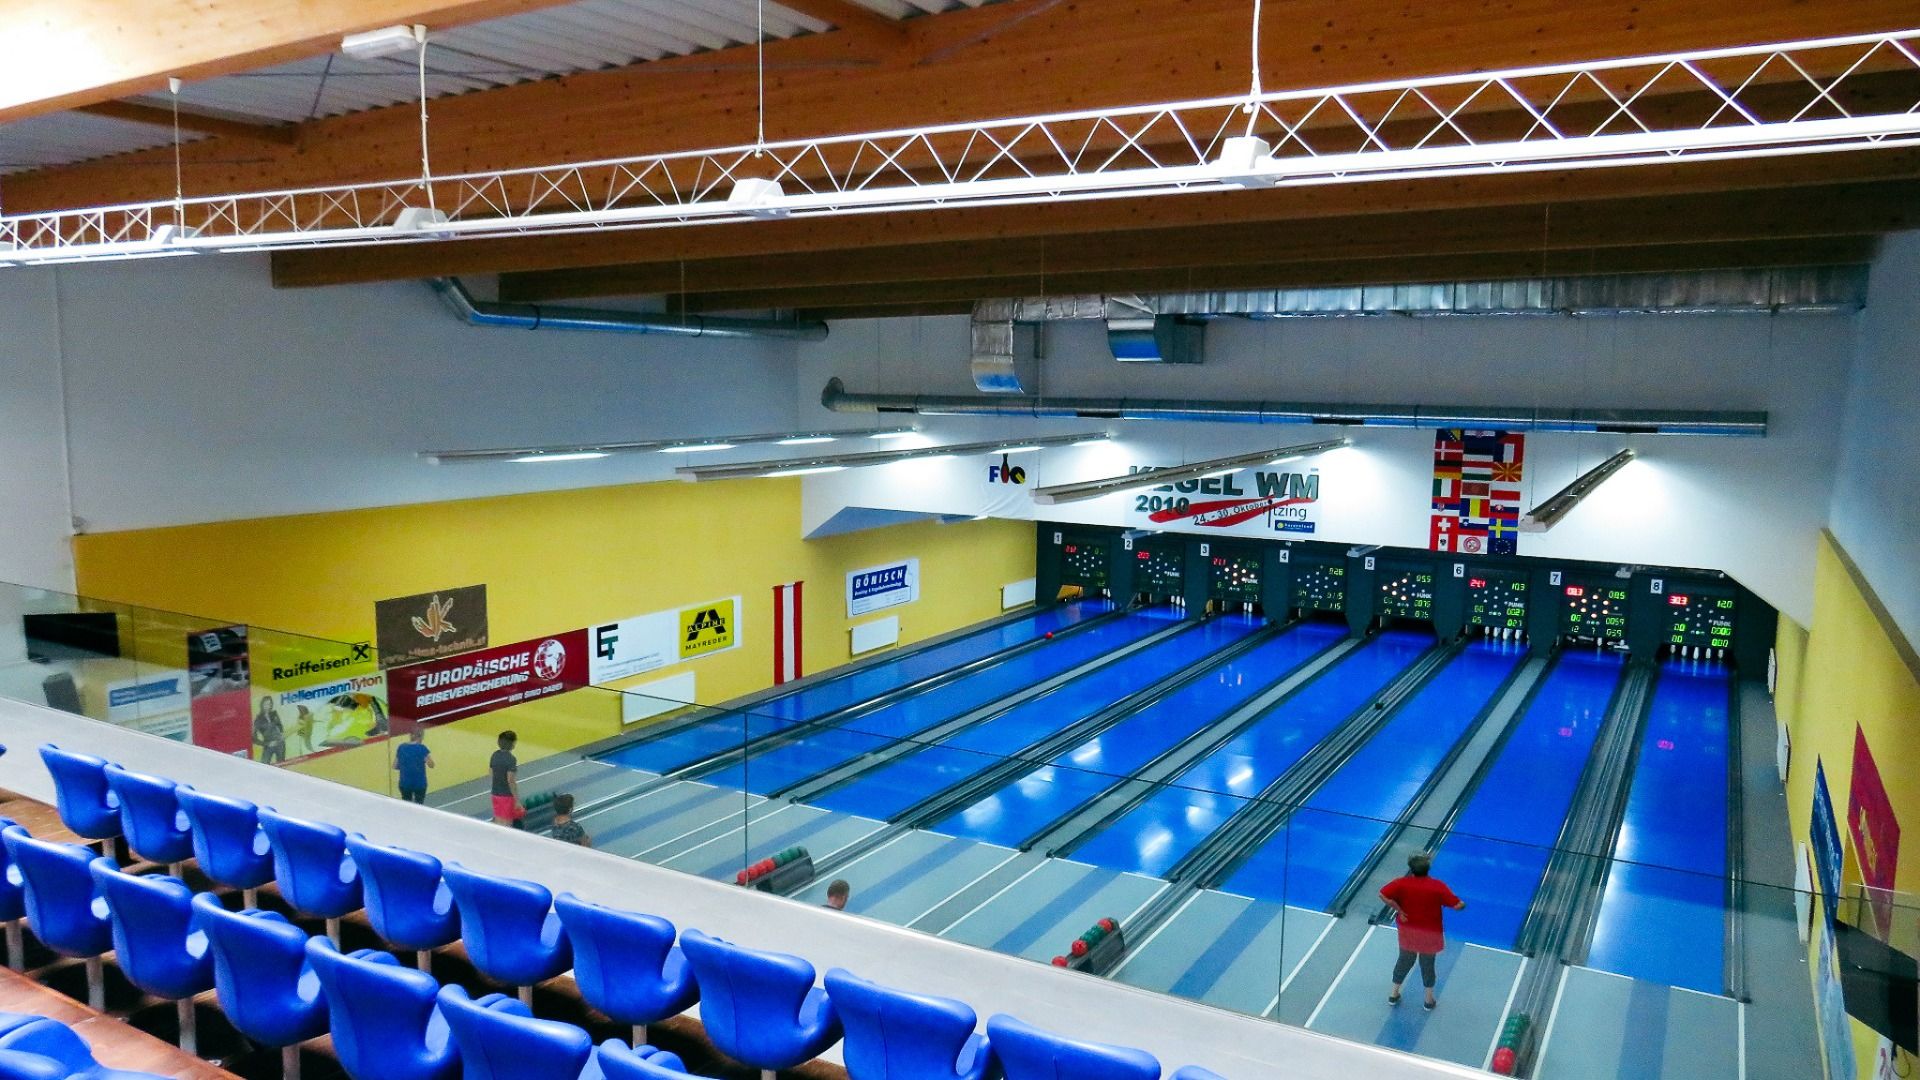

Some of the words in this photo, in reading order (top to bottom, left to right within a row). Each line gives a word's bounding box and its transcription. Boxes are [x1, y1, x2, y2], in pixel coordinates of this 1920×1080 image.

[1255, 471, 1320, 501] WM
[1134, 494, 1190, 514] 2010
[1192, 513, 1211, 526] 24.
[1281, 552, 1287, 560] 4
[1367, 559, 1373, 567] 5
[1456, 566, 1462, 574] 6
[1552, 574, 1559, 582] 7
[855, 569, 904, 589] BÖNISCH
[1653, 582, 1660, 591] 8
[1716, 600, 1733, 609] 120
[687, 617, 726, 633] ALPINE
[685, 635, 728, 651] MAYREDER
[272, 656, 351, 681] Raiffeisen
[415, 651, 531, 692] EUROPÄISCHE
[280, 674, 384, 706] HellermannTyton
[416, 670, 531, 708] REISEVERSICHERUNG
